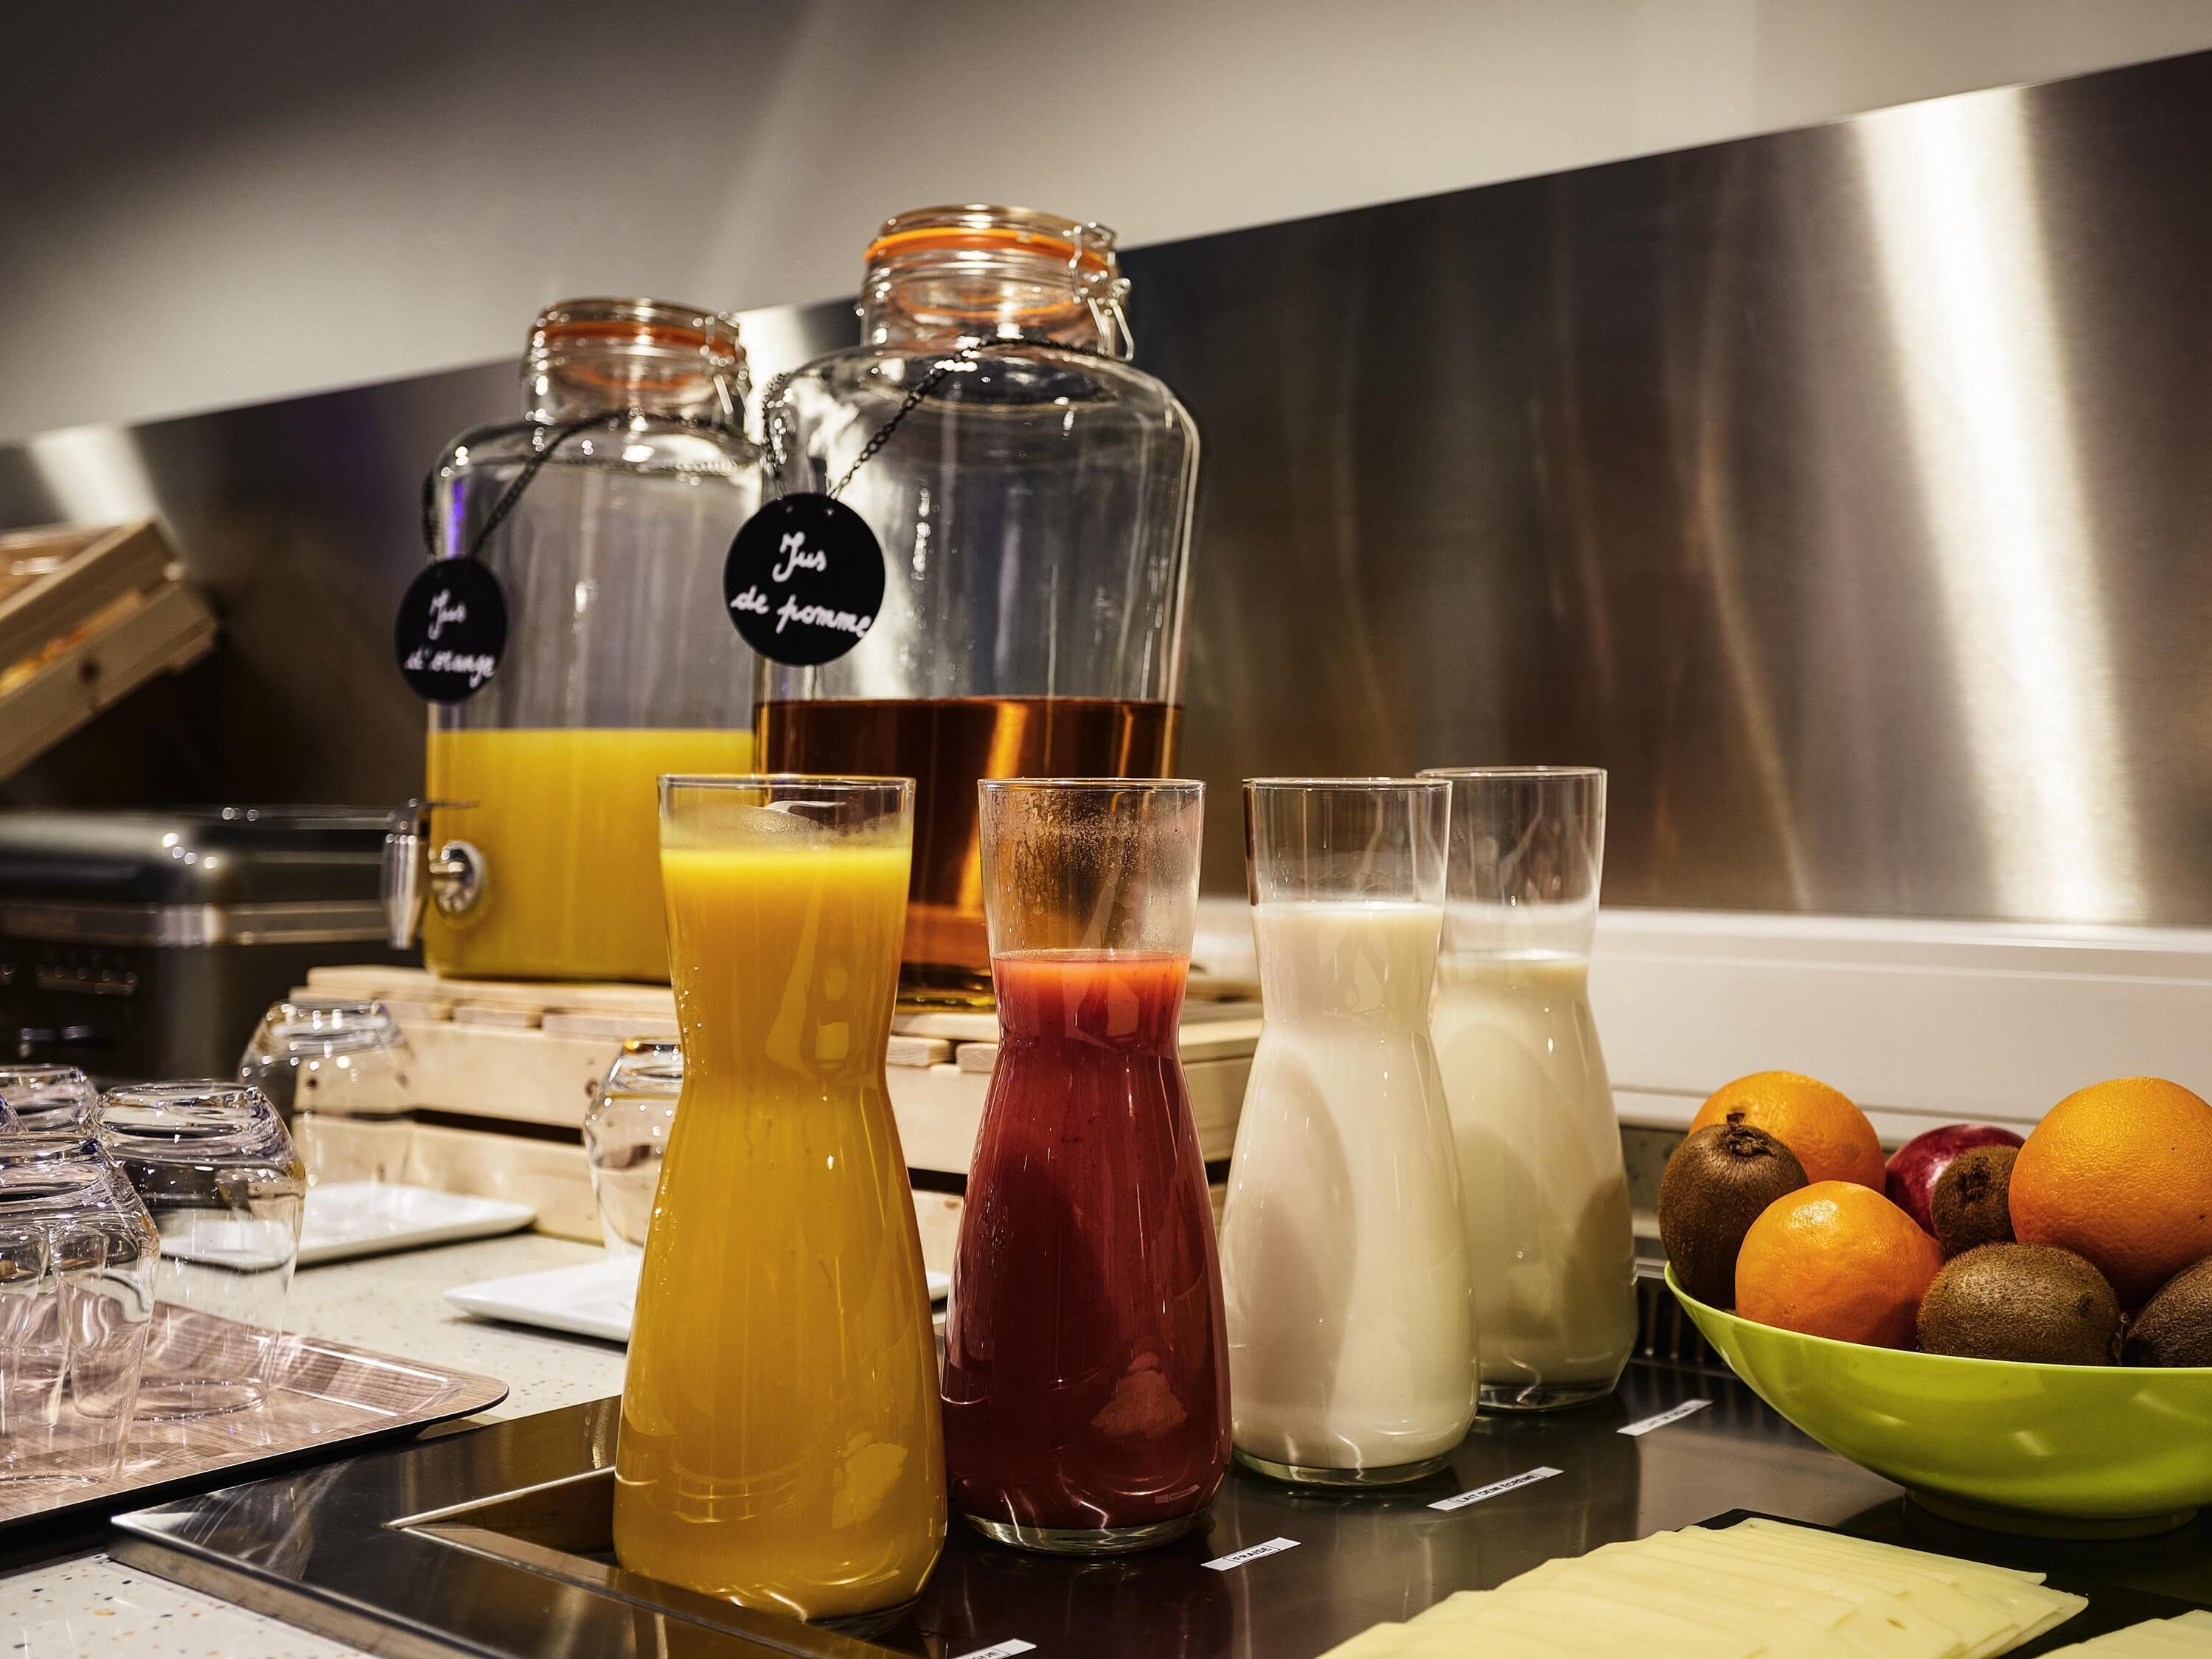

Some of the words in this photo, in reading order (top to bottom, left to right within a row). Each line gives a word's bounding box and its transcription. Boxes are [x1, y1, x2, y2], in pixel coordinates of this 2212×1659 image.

[772, 531, 827, 582] Jus
[428, 588, 467, 640] Jus
[730, 585, 770, 615] de
[776, 594, 872, 639] pomme
[1456, 1494, 1479, 1503] LAIT
[1232, 1547, 1272, 1560] FRAISE
